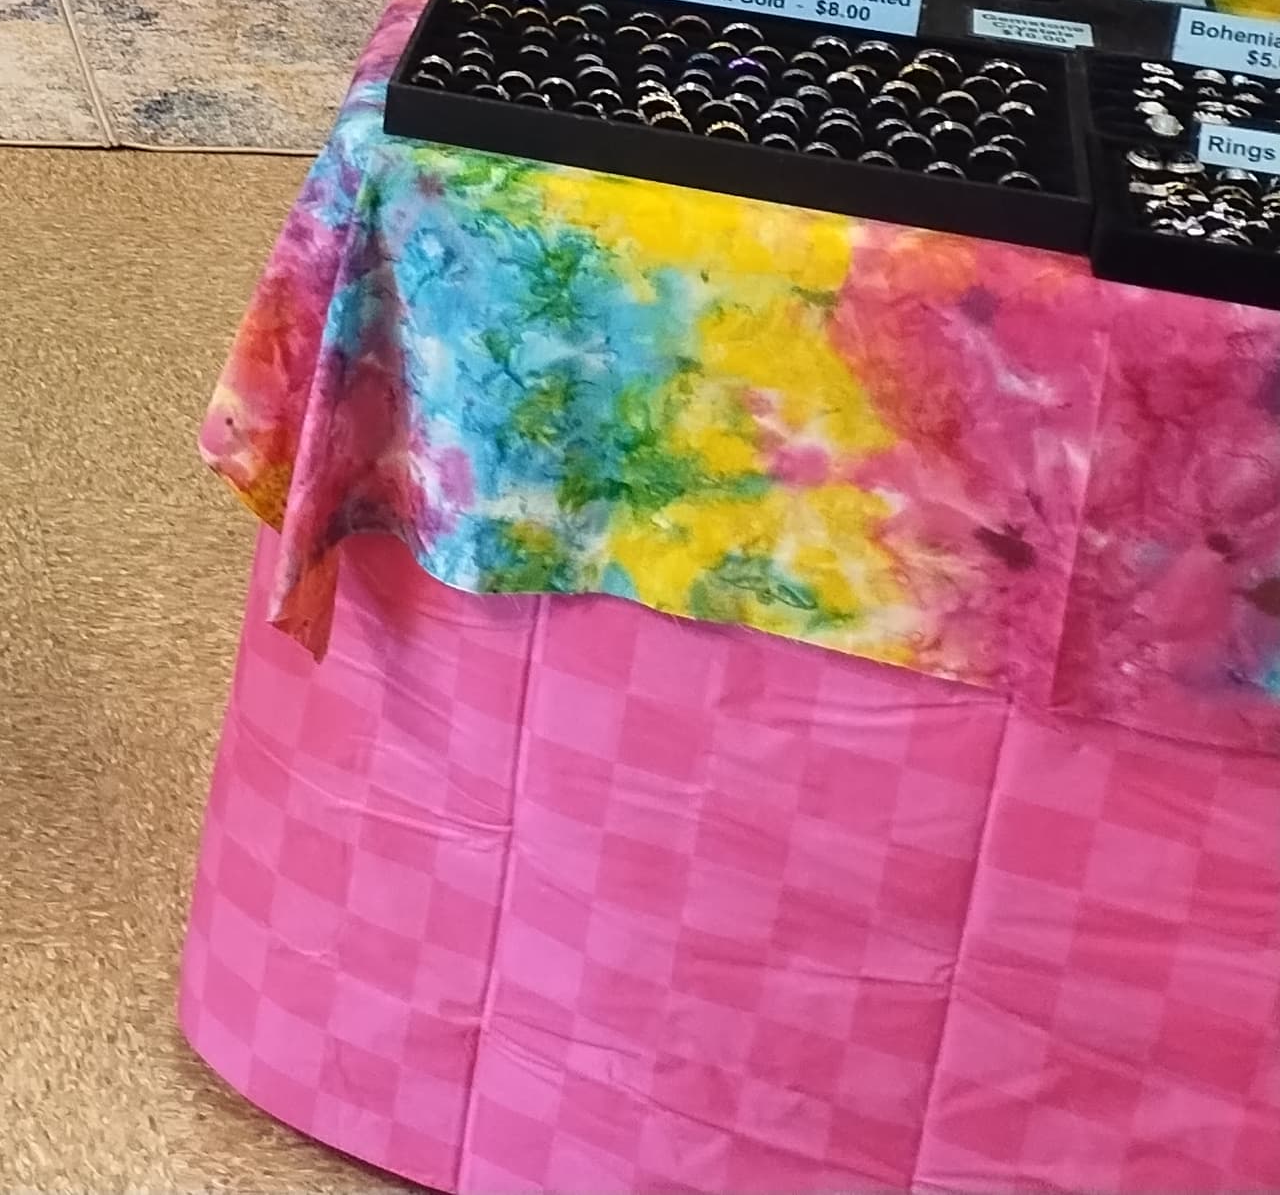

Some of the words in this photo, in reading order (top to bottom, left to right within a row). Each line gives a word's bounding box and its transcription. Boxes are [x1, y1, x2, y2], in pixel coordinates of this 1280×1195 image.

[815, 0, 871, 22] $8.00
[981, 13, 1084, 33] Gemstone
[992, 21, 1075, 38] Crystals
[1207, 134, 1276, 163] Rings
